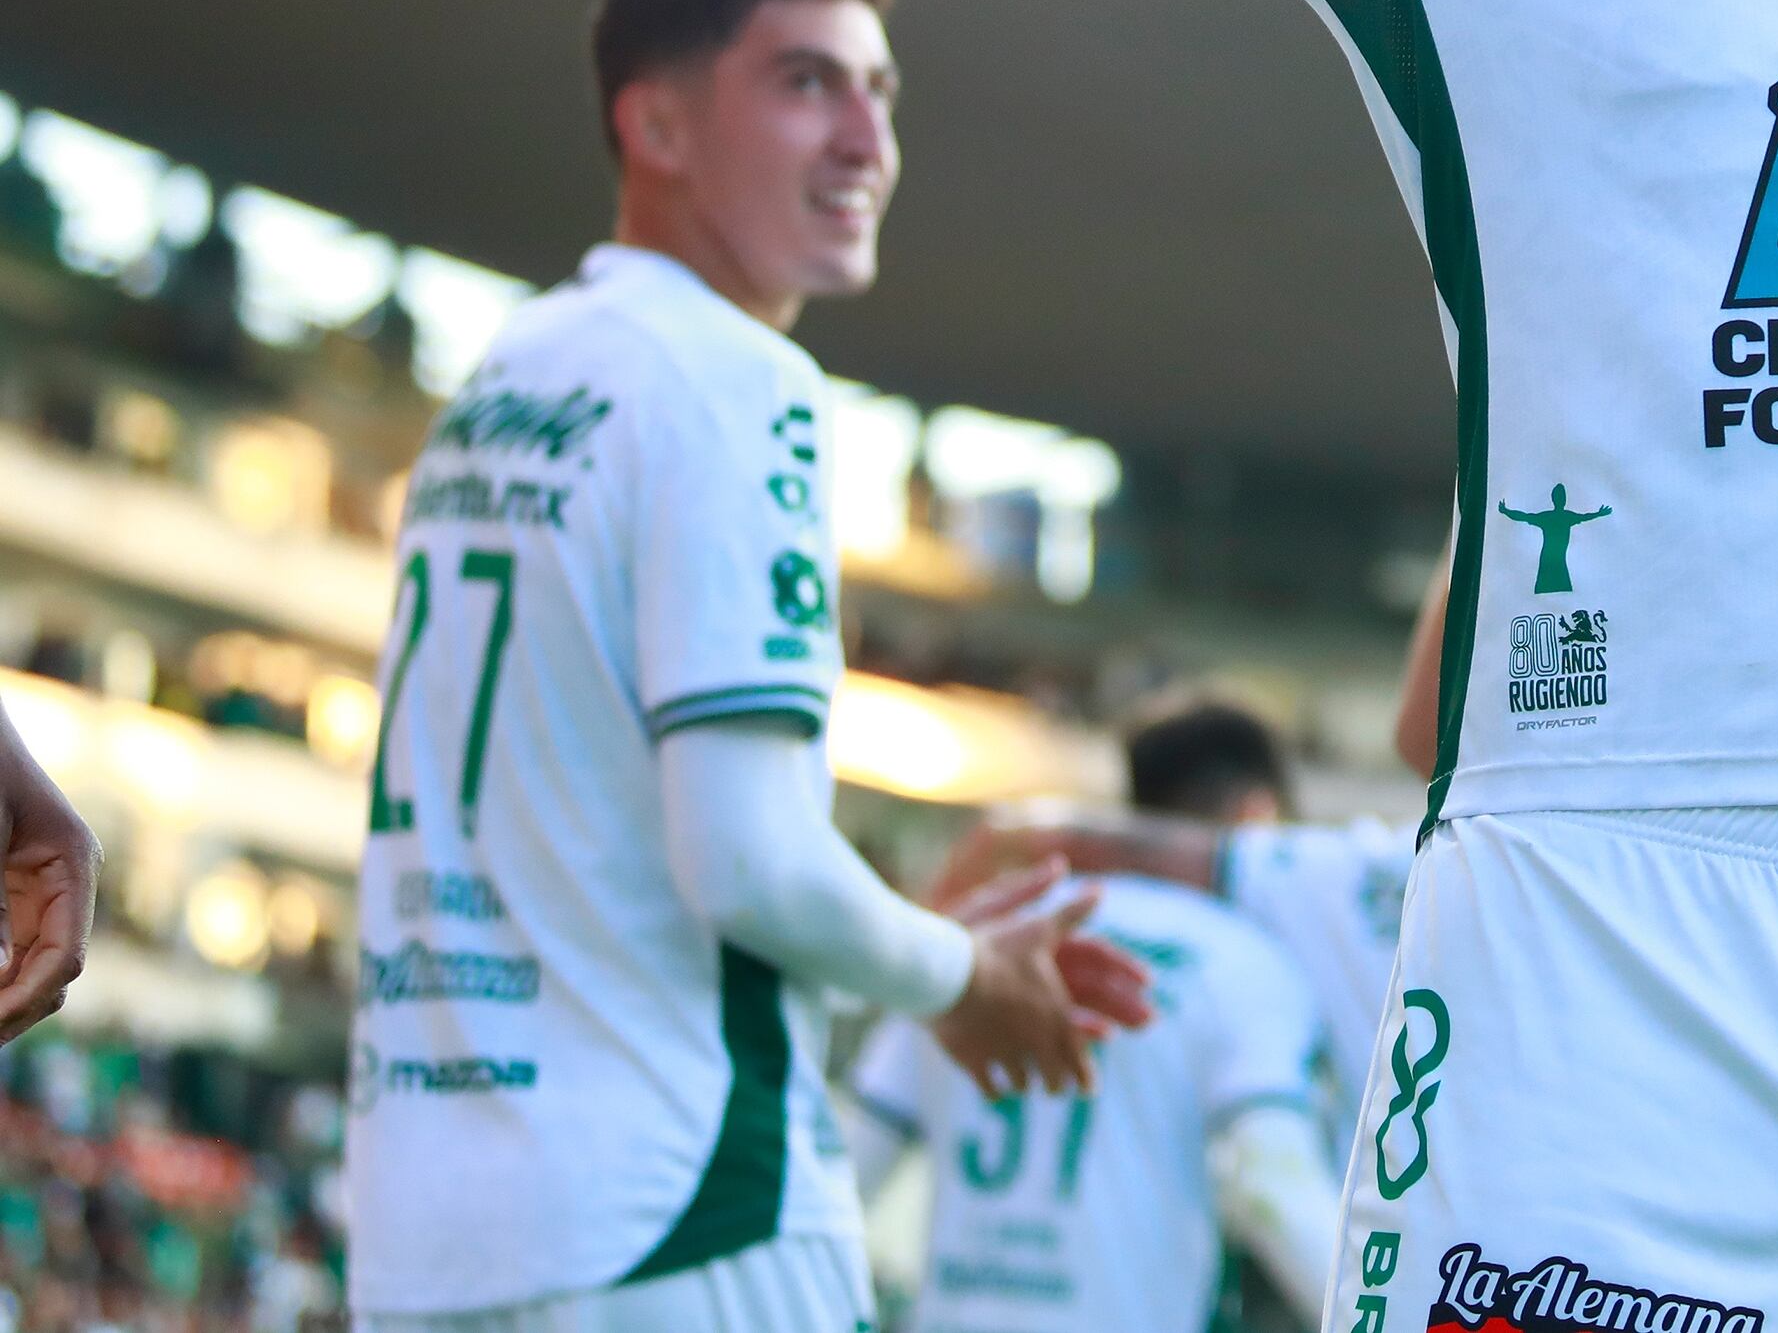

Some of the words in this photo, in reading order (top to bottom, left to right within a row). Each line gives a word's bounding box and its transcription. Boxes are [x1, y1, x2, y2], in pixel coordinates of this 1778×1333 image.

[1509, 613, 1560, 679] 80
[1561, 643, 1607, 675] AÑOS
[1509, 674, 1607, 713] RUGIENDO
[1445, 1250, 1502, 1324] La
[1512, 1264, 1758, 1333] Alemana
